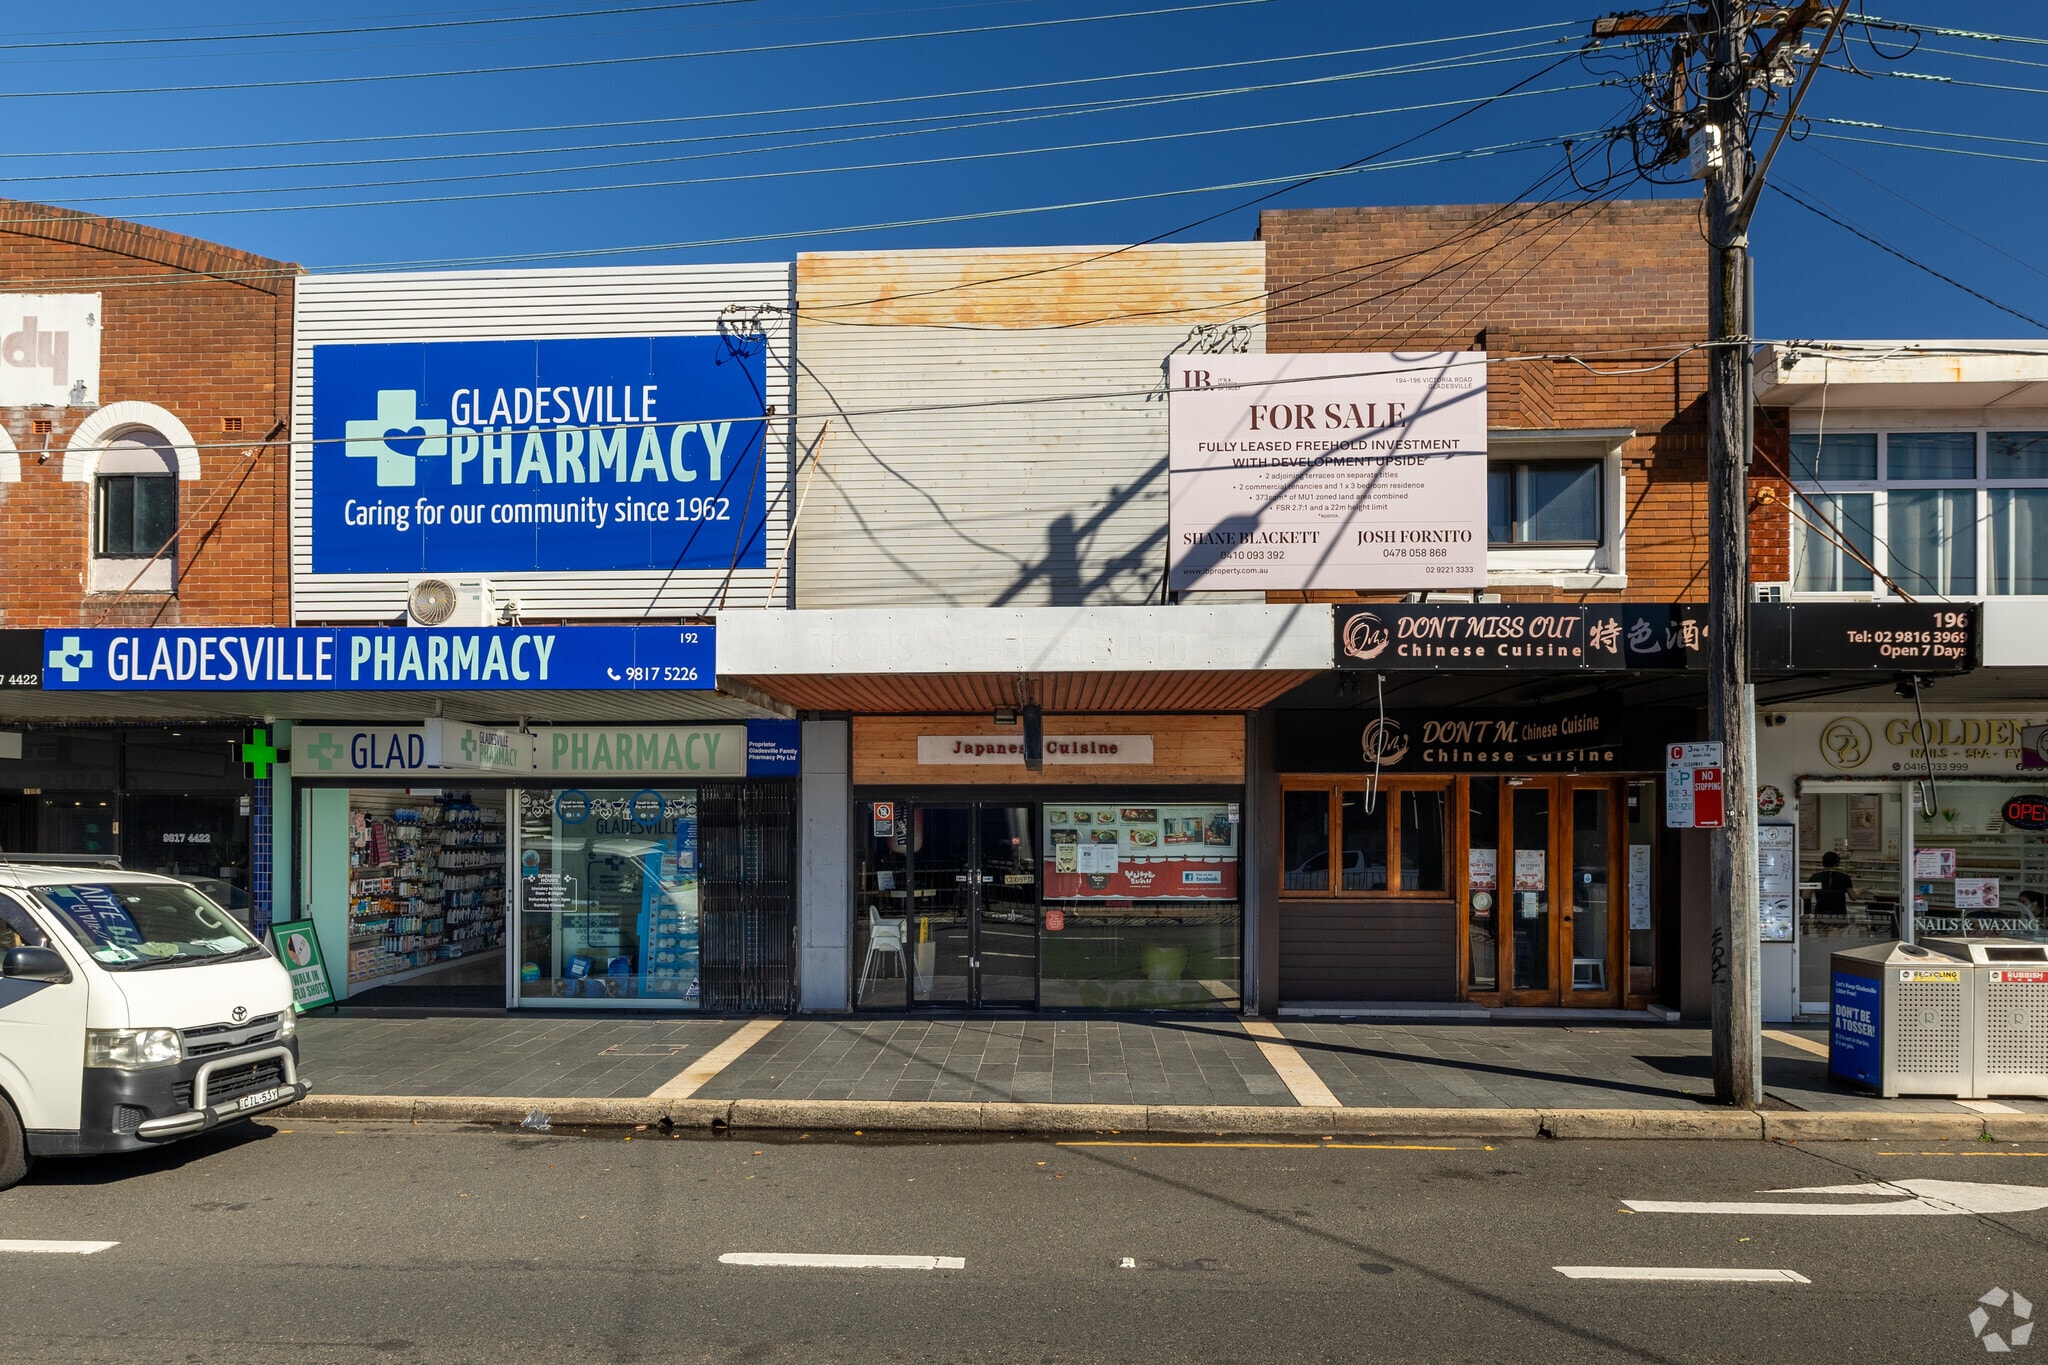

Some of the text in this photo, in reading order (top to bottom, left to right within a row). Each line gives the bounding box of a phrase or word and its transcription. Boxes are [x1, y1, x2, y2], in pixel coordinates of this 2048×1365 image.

[450, 385, 658, 426] GLADESVILLE
[1249, 402, 1407, 431] FOR SALE
[1198, 439, 1460, 453] FULLY LEASED FREEHOLD INVESTMENT
[451, 422, 732, 486] PHARMACY
[1232, 456, 1425, 468] WITH DEVELOPMENT UPSIDE
[1271, 472, 1304, 480] adjoining
[1346, 472, 1378, 480] separate
[1373, 492, 1408, 500] combined
[344, 495, 731, 532] Caring for our community since 1962
[1348, 504, 1370, 512] height
[1183, 531, 1320, 545] SHANE BLACKETT
[1357, 529, 1472, 546] JOSH FORNITO
[1220, 550, 1285, 560] 0410 093 392
[1382, 548, 1448, 558] 0478 058 868
[1183, 567, 1269, 575] www.ibproperty.com.au
[1425, 566, 1474, 574] 02 9221 3333
[1933, 612, 1968, 628] 196
[1465, 616, 1525, 639] MISS
[1528, 616, 1582, 639] OUT
[679, 633, 698, 644] 192
[1589, 617, 1709, 654] 特色酒
[1847, 630, 1968, 643] Tel: 02 9816 3969
[1397, 643, 1582, 657] Chinese Cuisine
[1880, 644, 1967, 659] Open 7 Days
[107, 634, 556, 682] GLADESVILLE PHARMACY
[8, 674, 38, 685] 4422
[625, 666, 698, 681] 9817 5226
[1522, 721, 1558, 742] Chinese
[1561, 713, 1600, 736] Cuisine
[479, 731, 509, 748] GLADESVILLE
[480, 744, 518, 767] PHARMACY
[552, 732, 721, 770] PHARMACY
[952, 741, 1119, 757] Japanes Cuisine
[1422, 748, 1514, 763] Chinese
[1911, 748, 1991, 759] NAILS SPA
[1903, 762, 1926, 771] 0416
[1950, 762, 1969, 771] 999
[1702, 770, 1714, 780] NO
[1694, 782, 1721, 791] STOPPING
[596, 818, 678, 835] GLADESVILLE
[162, 832, 211, 843] 9817 4422
[1006, 875, 1032, 883] CLOSED
[1914, 918, 2040, 931] NAILS & WAXING
[292, 970, 320, 986] WALK IN
[2007, 971, 2044, 979] RUBBISH
[294, 982, 327, 1000] FLU SHOTS
[1836, 1004, 1872, 1024] DON'T BE
[1836, 1016, 1876, 1038] A TOSSER!
